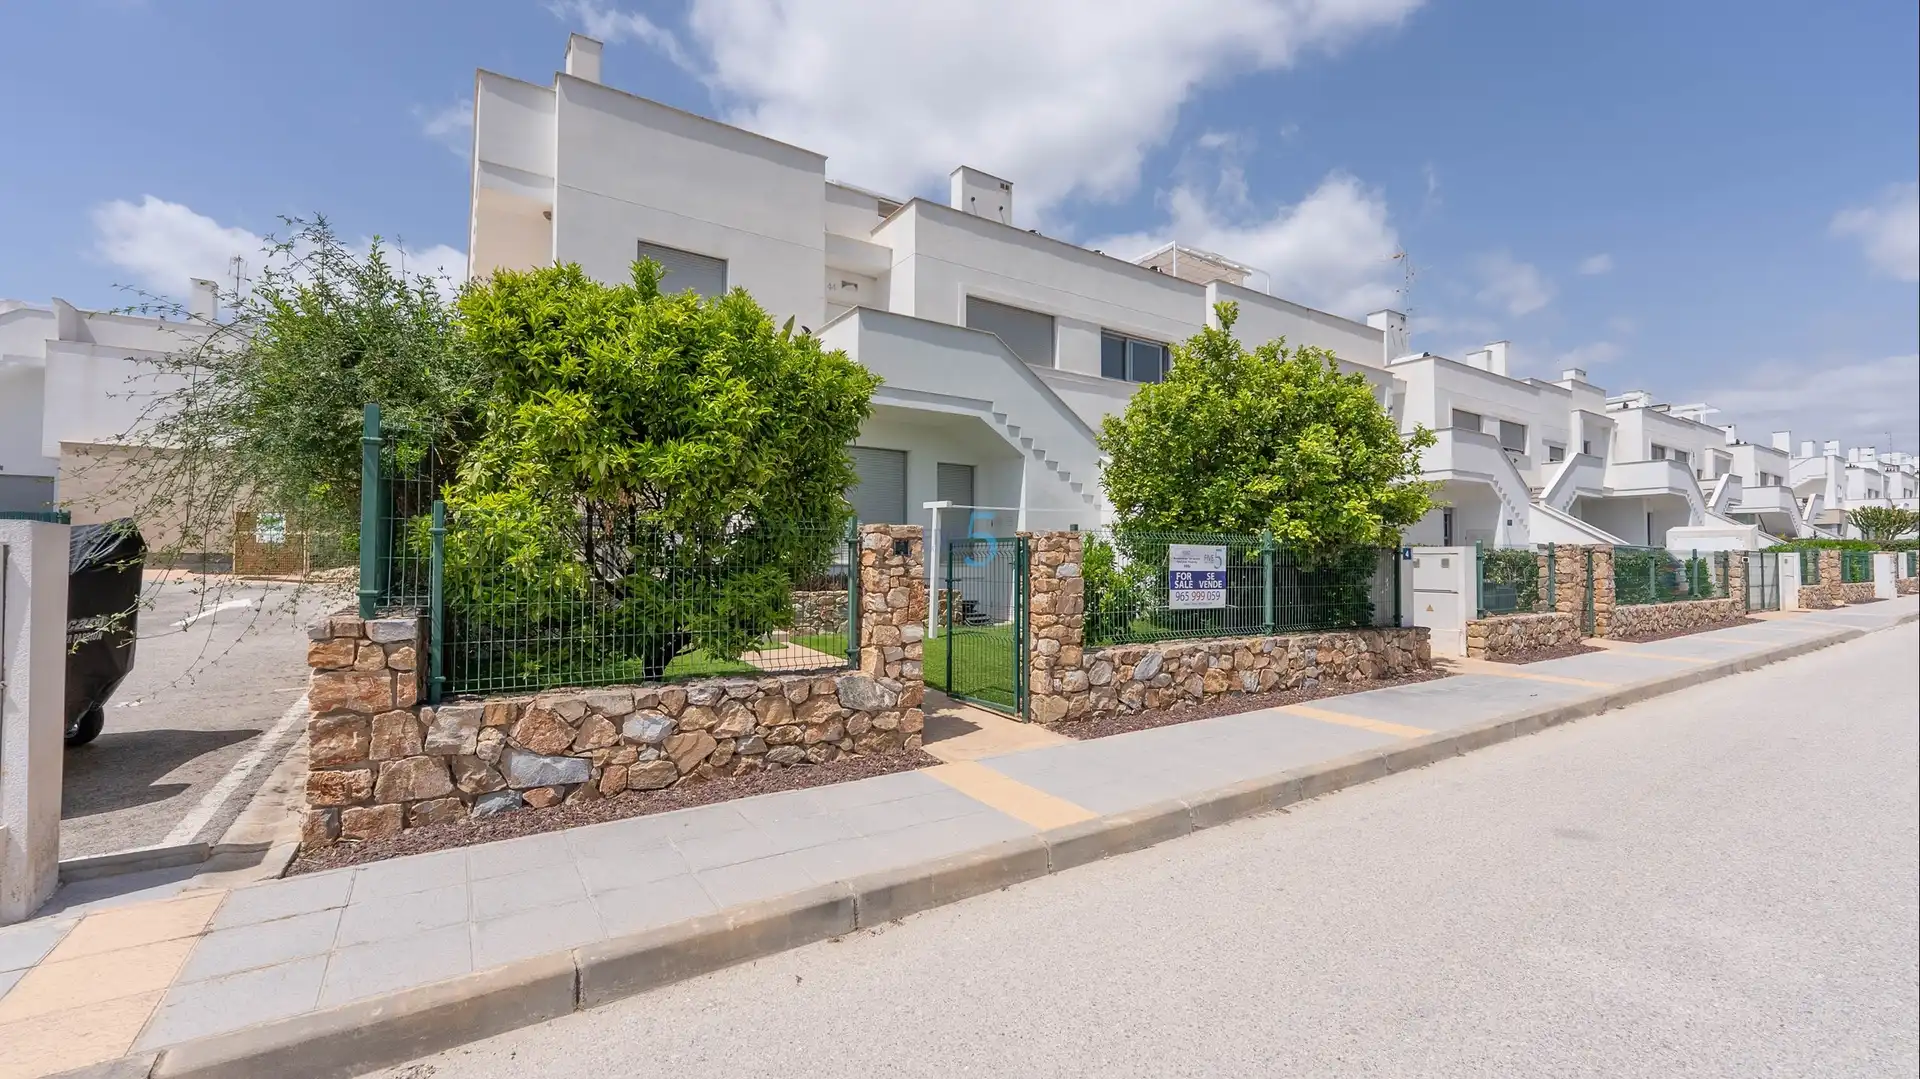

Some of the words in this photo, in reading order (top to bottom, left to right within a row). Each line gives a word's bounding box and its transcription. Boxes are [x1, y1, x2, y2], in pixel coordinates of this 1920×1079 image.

[1176, 572, 1192, 580] FOR
[1206, 572, 1216, 580] SE
[1174, 580, 1193, 589] SALE
[1199, 580, 1223, 588] VENDE
[1175, 591, 1189, 601] 965
[1191, 591, 1205, 601] 999
[1207, 591, 1220, 600] 059
